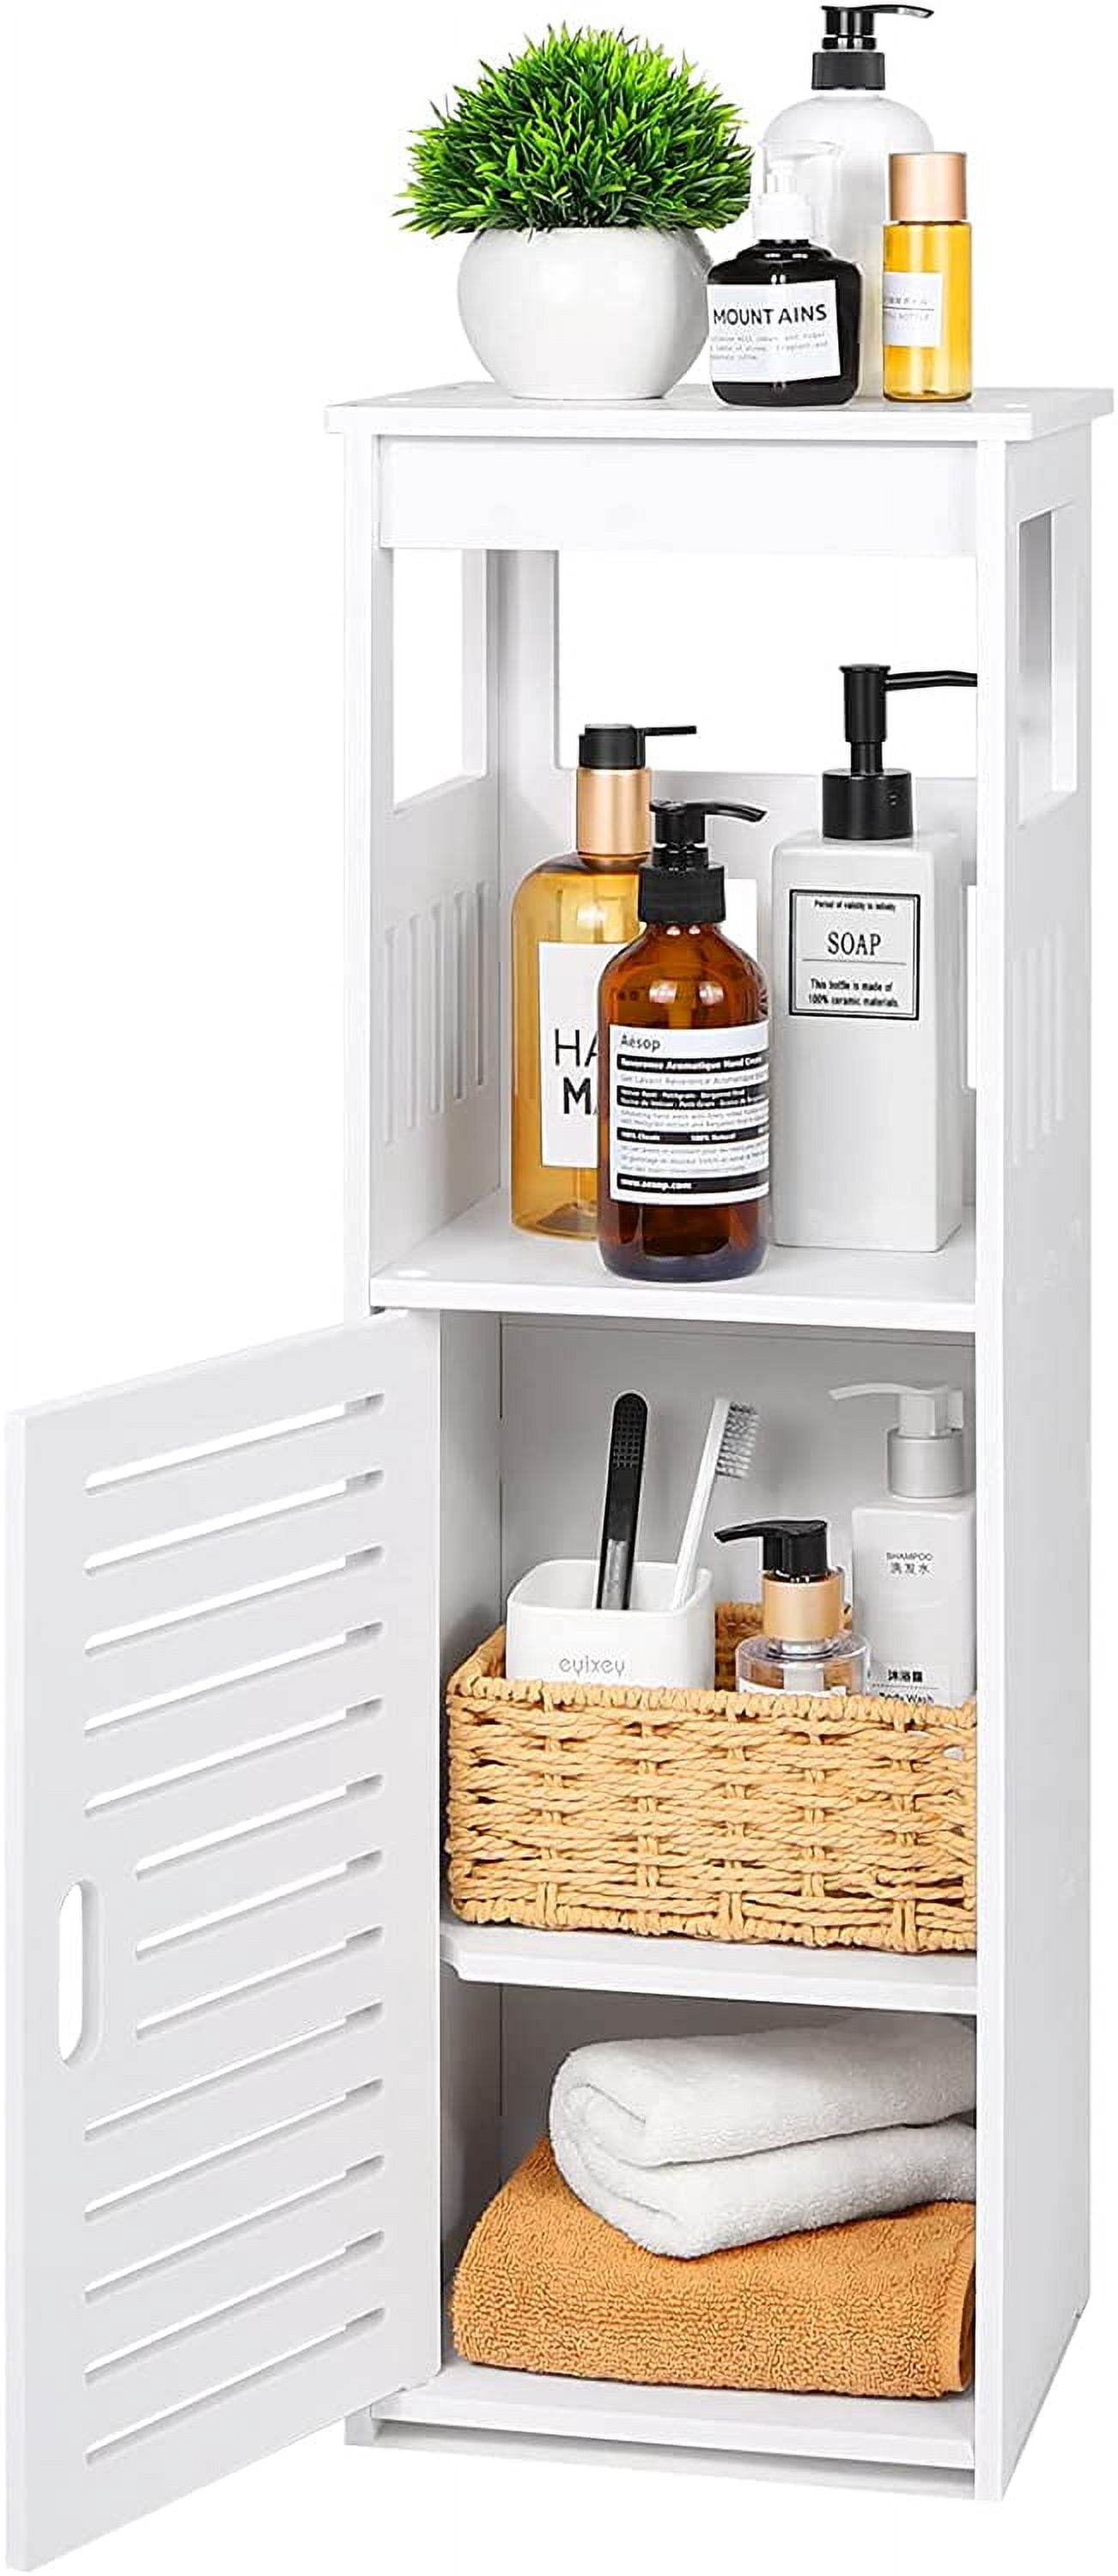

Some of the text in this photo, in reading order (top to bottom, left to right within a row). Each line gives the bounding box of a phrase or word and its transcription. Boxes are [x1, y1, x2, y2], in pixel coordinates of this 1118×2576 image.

[827, 931, 881, 956] SOAP
[811, 978, 893, 992] This bottle is made of
[809, 993, 829, 1004] 100%
[831, 995, 860, 1005] ceramic
